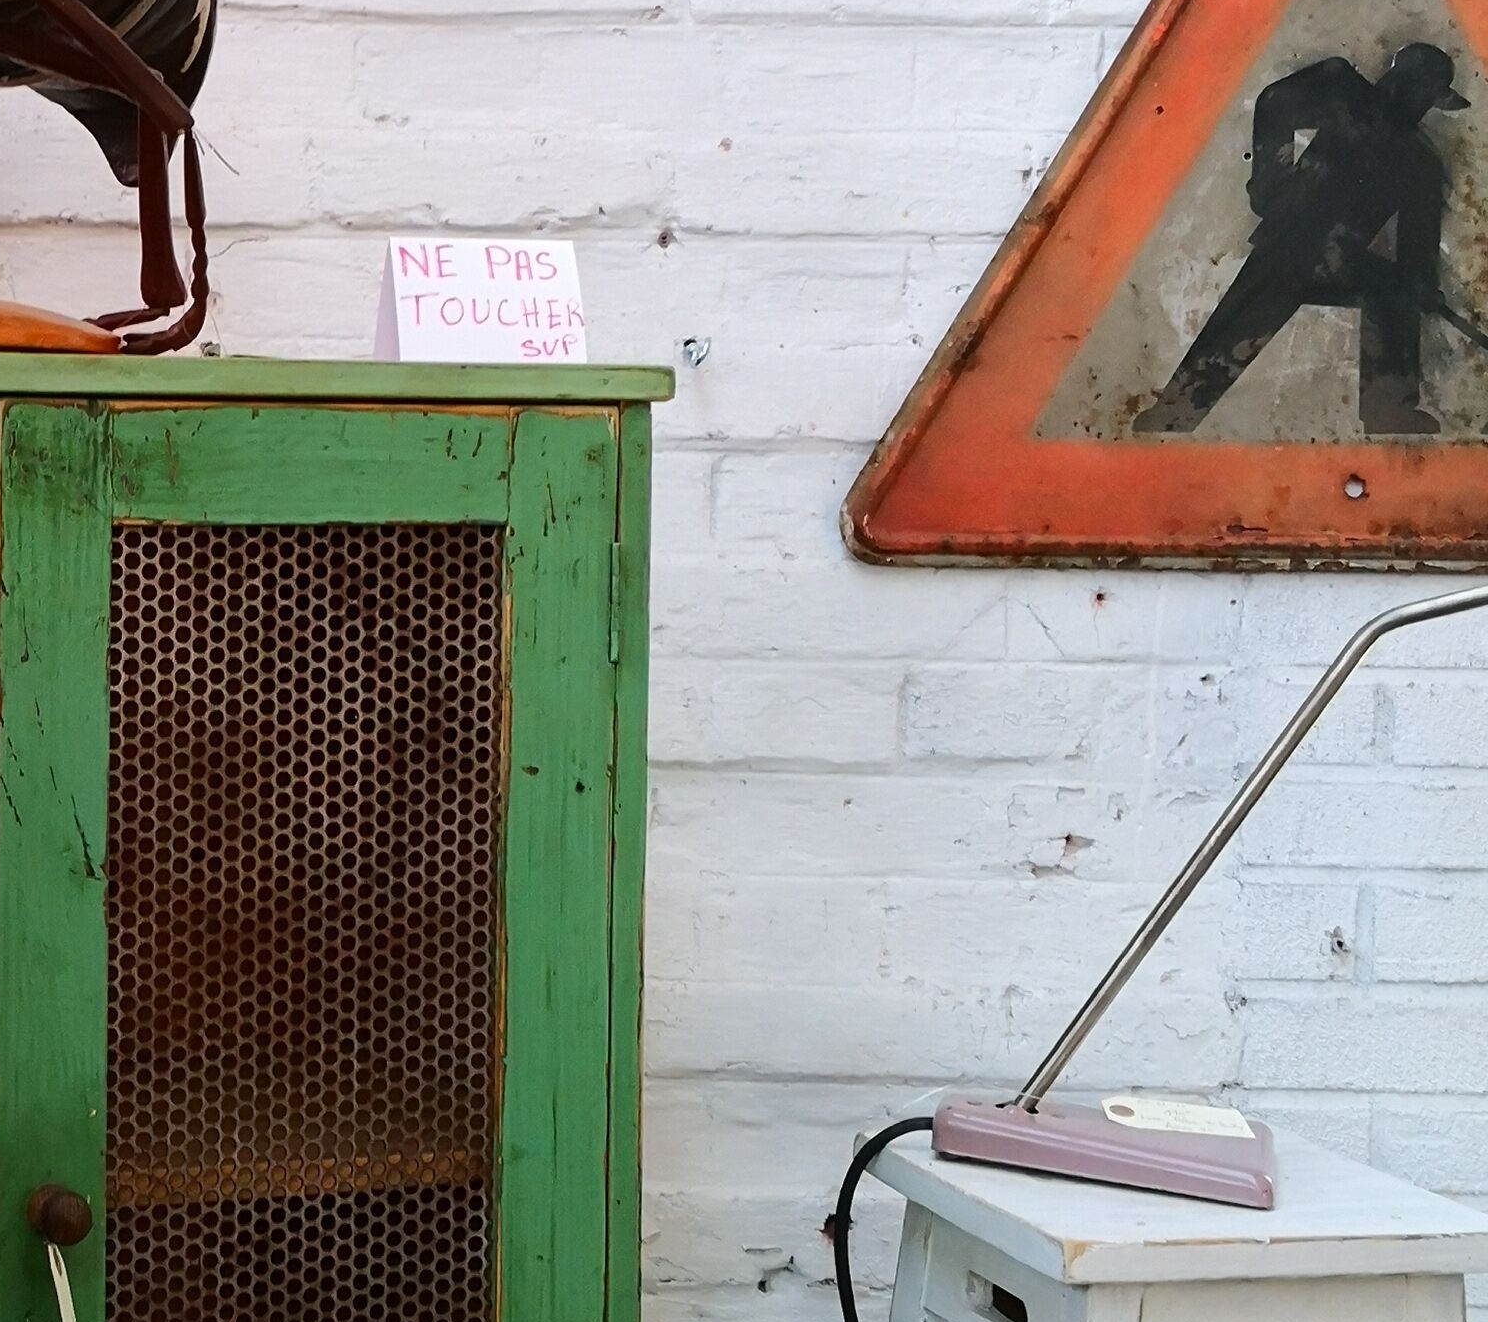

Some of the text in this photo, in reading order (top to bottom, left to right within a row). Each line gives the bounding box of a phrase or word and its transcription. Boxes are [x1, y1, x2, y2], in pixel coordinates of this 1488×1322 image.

[398, 243, 558, 281] NE PAS
[399, 292, 586, 329] TOUCHER
[520, 333, 578, 358] SVP
